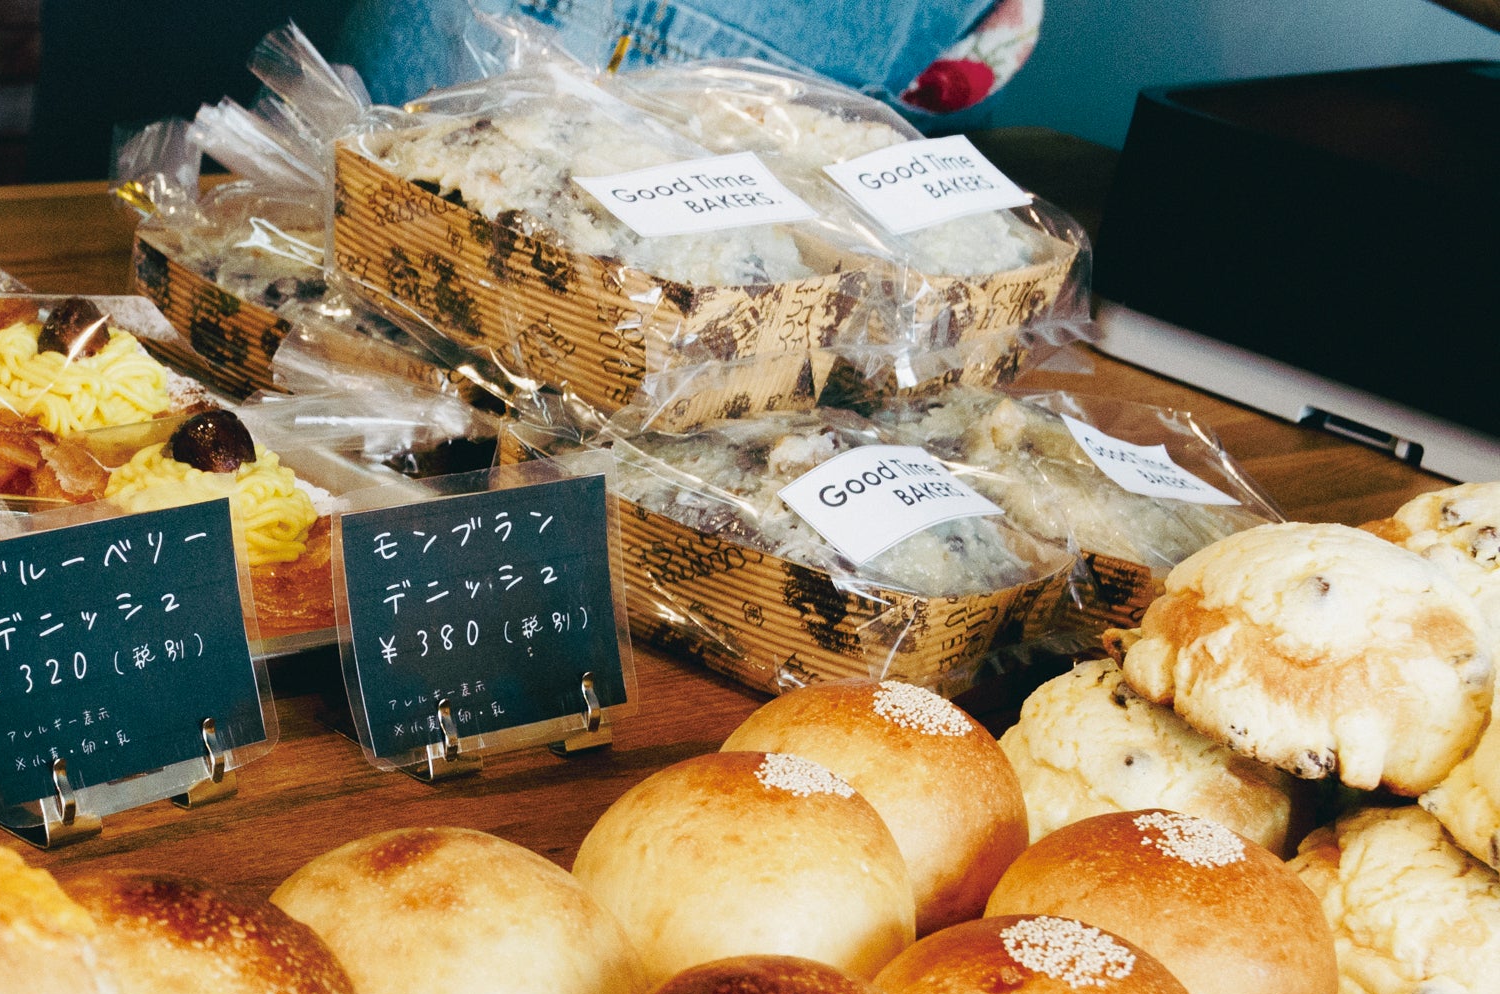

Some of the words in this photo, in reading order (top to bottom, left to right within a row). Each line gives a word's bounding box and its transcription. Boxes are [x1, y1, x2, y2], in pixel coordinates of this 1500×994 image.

[611, 177, 692, 203] Good
[691, 174, 757, 192] Time
[858, 156, 928, 191] Good
[924, 153, 975, 172] Time
[818, 460, 898, 508] Good
[889, 458, 941, 477] Time
[373, 511, 554, 560] モンブラン
